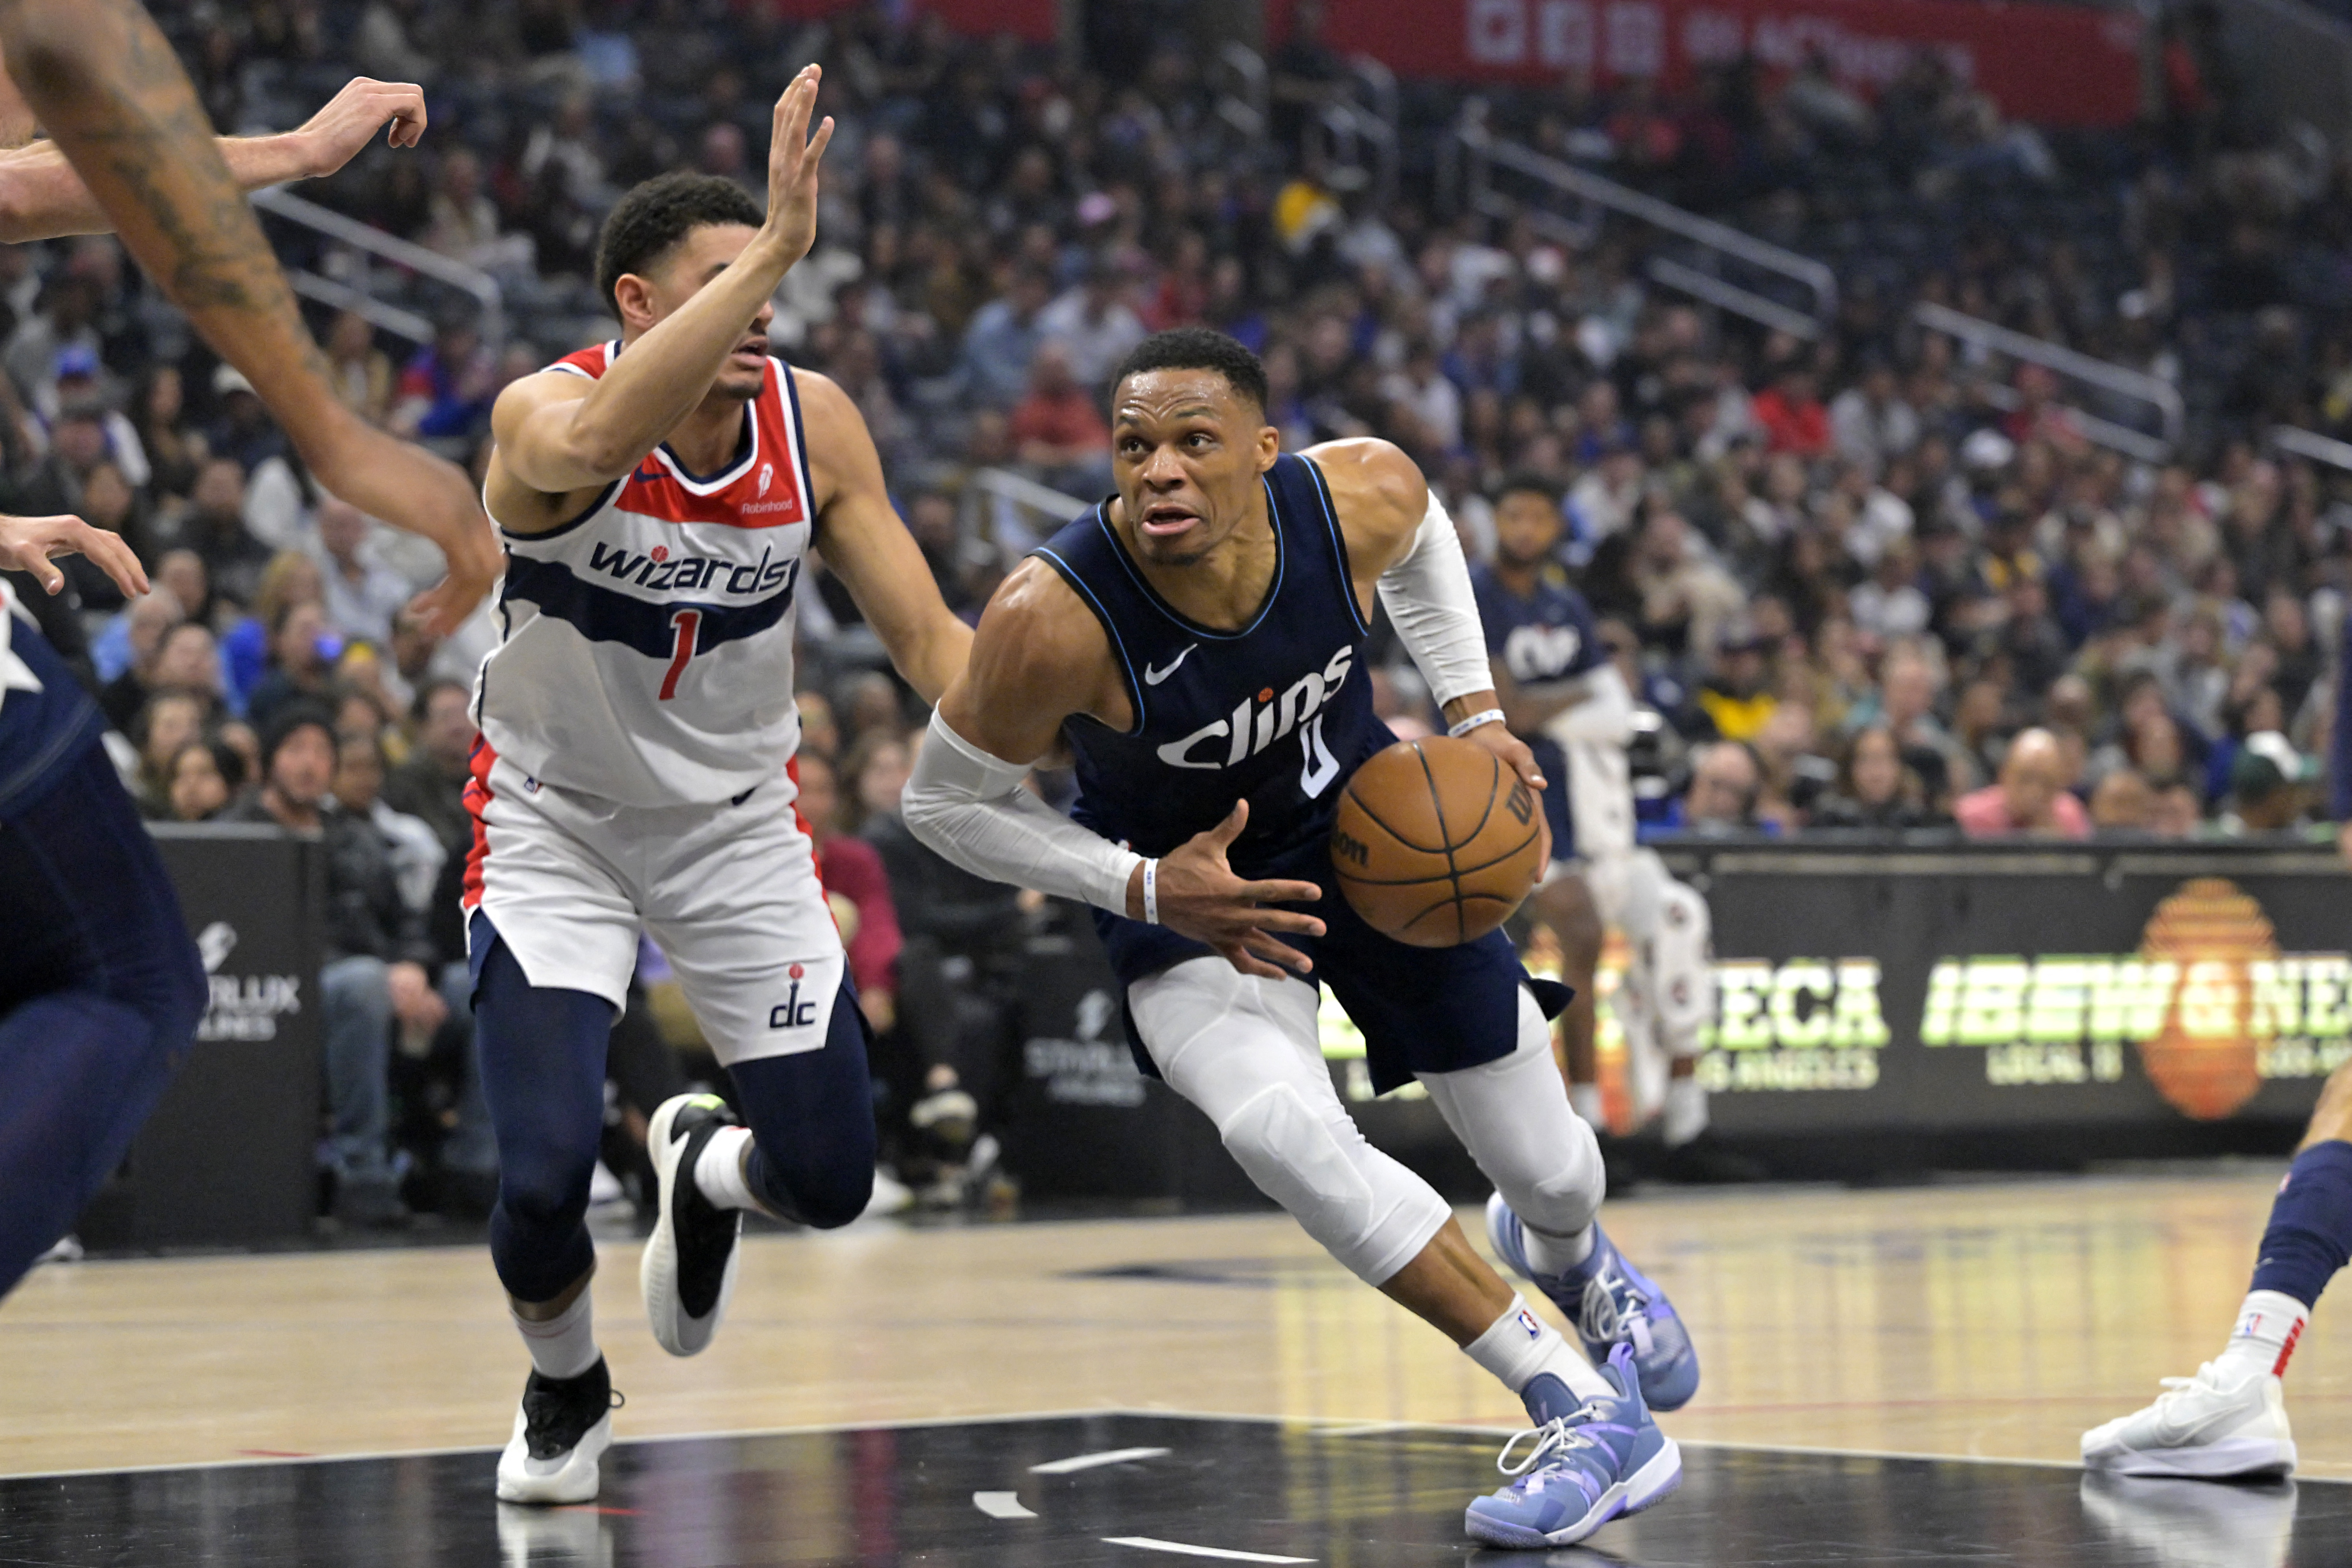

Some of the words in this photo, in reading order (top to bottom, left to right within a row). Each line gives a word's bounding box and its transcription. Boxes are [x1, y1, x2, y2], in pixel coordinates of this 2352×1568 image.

[742, 498, 792, 515] Robinhood
[589, 541, 793, 594] wizards
[659, 608, 702, 701] 1
[1156, 645, 1352, 769] clips
[770, 963, 816, 1028] dc
[1697, 958, 1891, 1048] ECA
[2247, 956, 2352, 1039] NE
